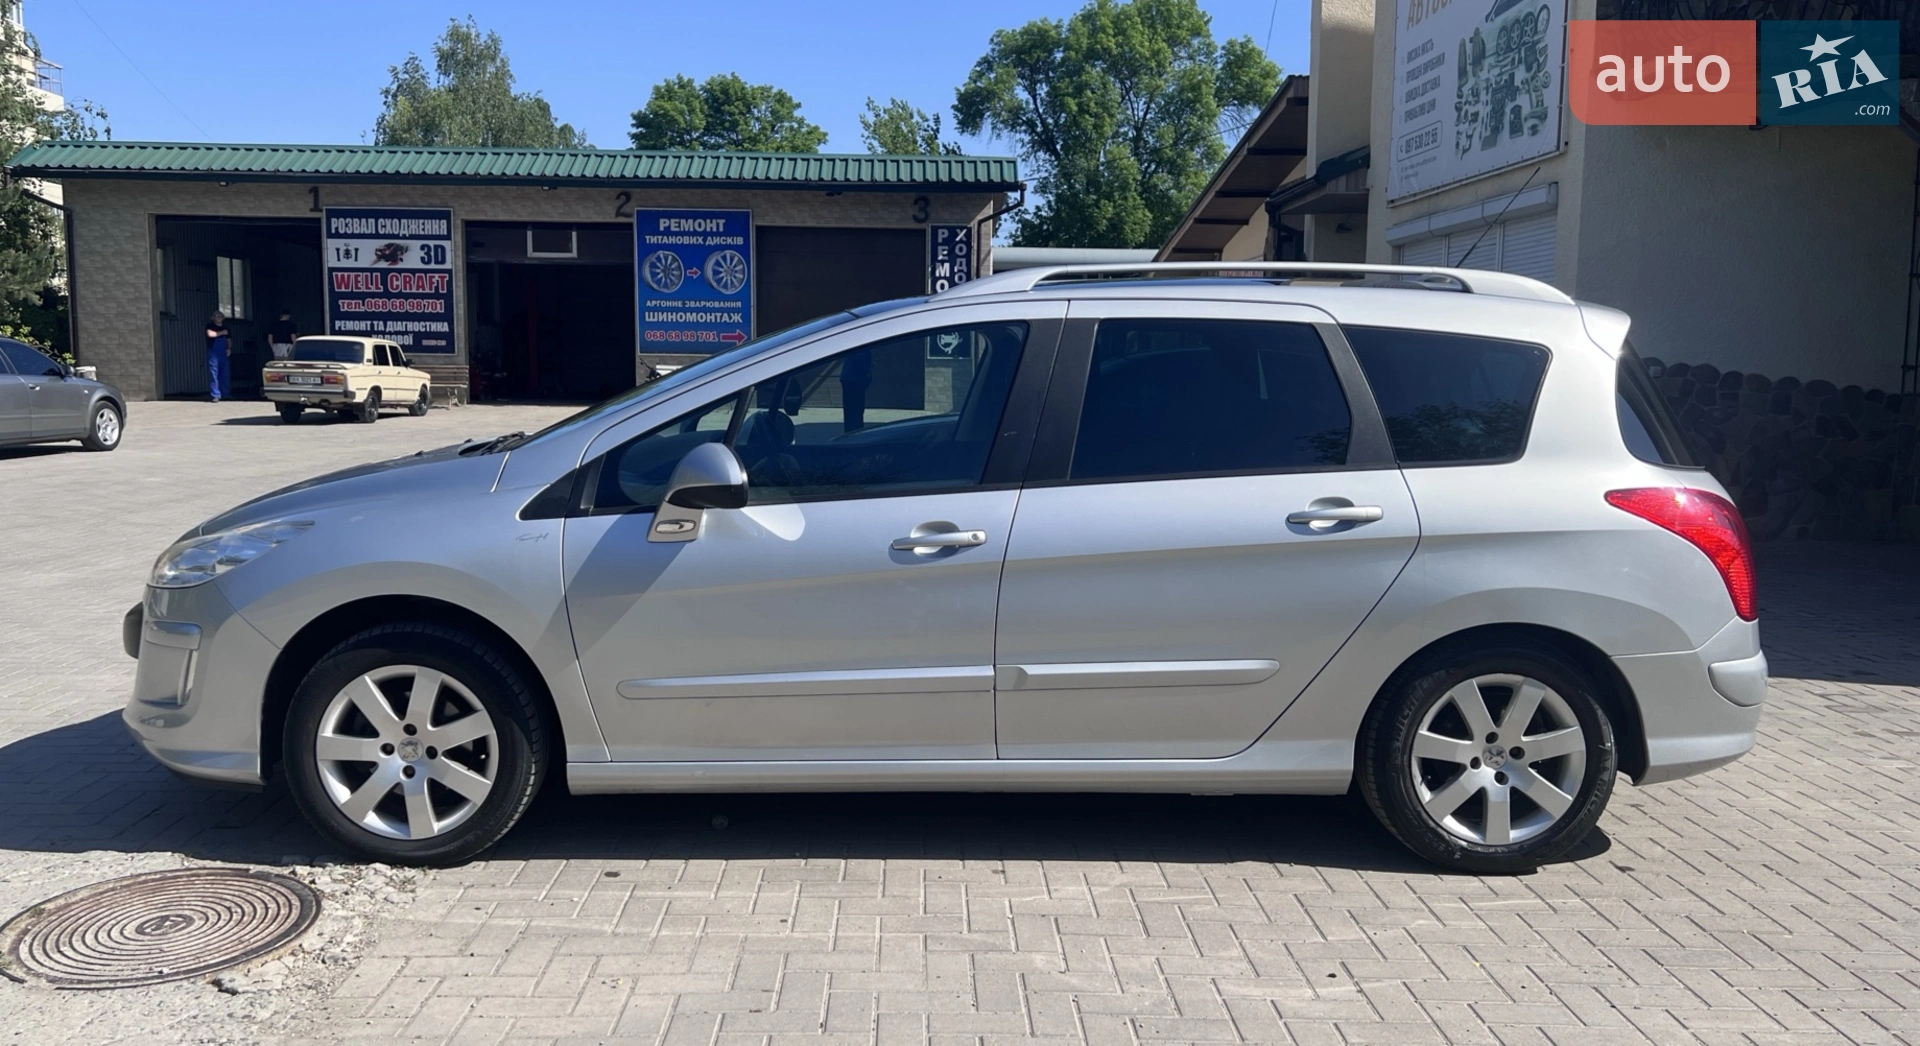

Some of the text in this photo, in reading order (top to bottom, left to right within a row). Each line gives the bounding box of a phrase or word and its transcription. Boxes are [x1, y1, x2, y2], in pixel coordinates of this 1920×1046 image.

[1424, 130, 1430, 147] 22
[614, 191, 632, 218] 2
[912, 195, 930, 224] 3
[331, 218, 447, 237] РОЗВАЛ СХОДЖЕННЯ
[659, 218, 725, 232] РЕМОНТ
[645, 235, 744, 246] ТИТАНОВИХ ДИСКІВ
[420, 244, 446, 265] 3D
[333, 272, 448, 293] WELL CRAFT
[365, 298, 387, 312] 068
[389, 299, 406, 312] 68
[407, 299, 423, 312] 98
[424, 300, 444, 312] 701
[645, 312, 743, 323] ШИНОМОНТАЖ
[335, 320, 449, 333] РЕМОНТ ТА ДІАГНОСТИКА
[645, 330, 718, 341] 068 68 98 701
